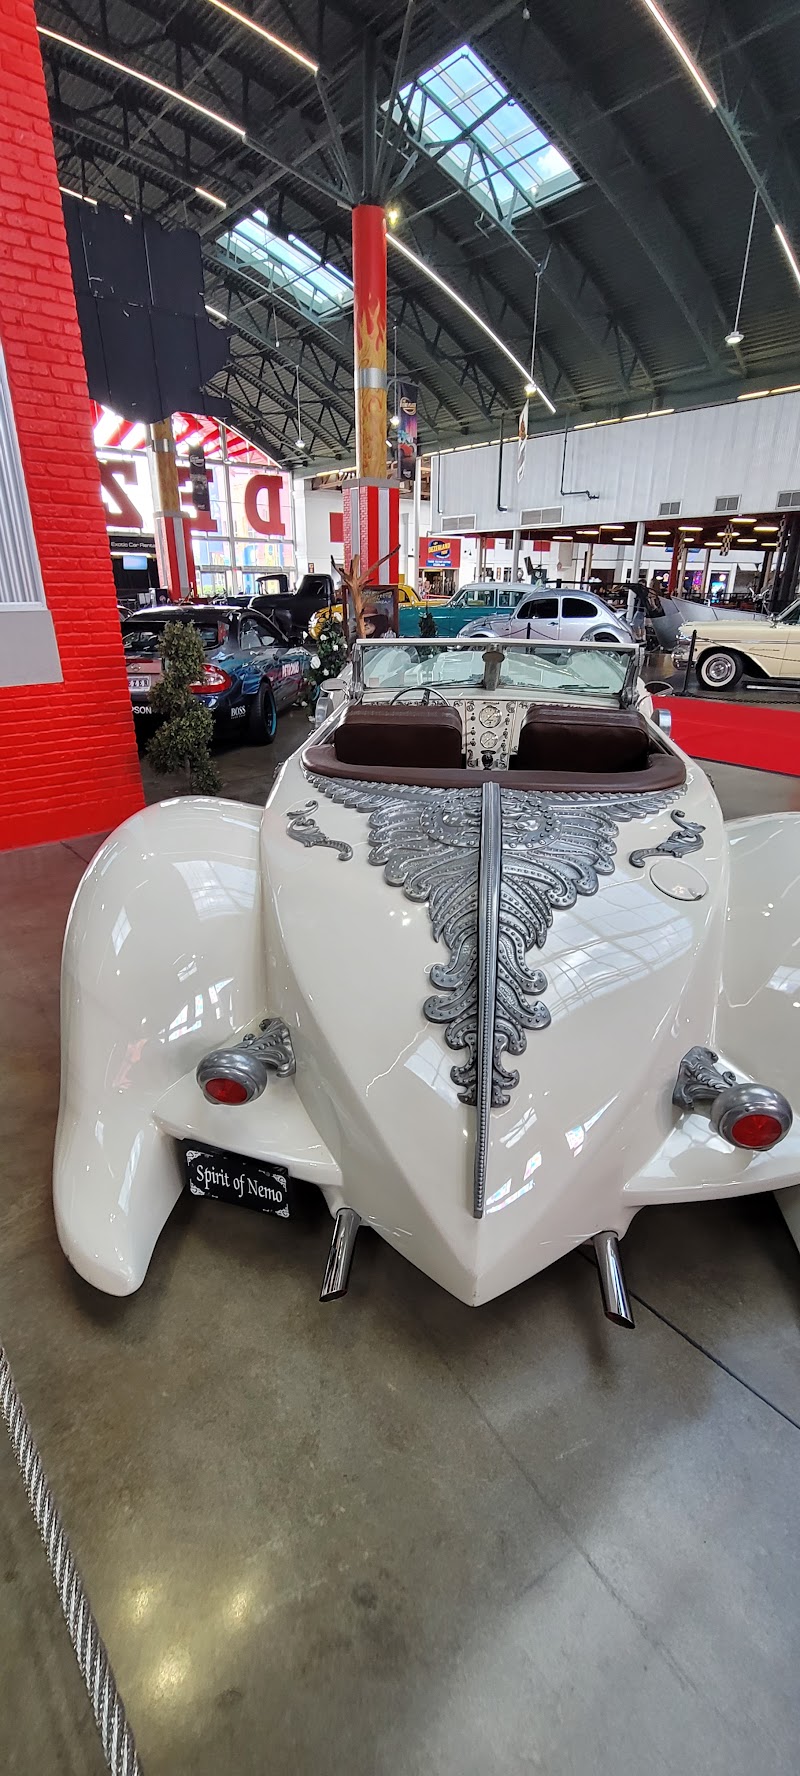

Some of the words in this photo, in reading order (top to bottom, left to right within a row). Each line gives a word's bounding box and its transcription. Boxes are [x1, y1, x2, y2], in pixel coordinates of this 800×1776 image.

[230, 705, 246, 717] BOSS
[196, 1164, 230, 1190] Spirit
[233, 1173, 246, 1198] of
[247, 1178, 283, 1203] Nemo
